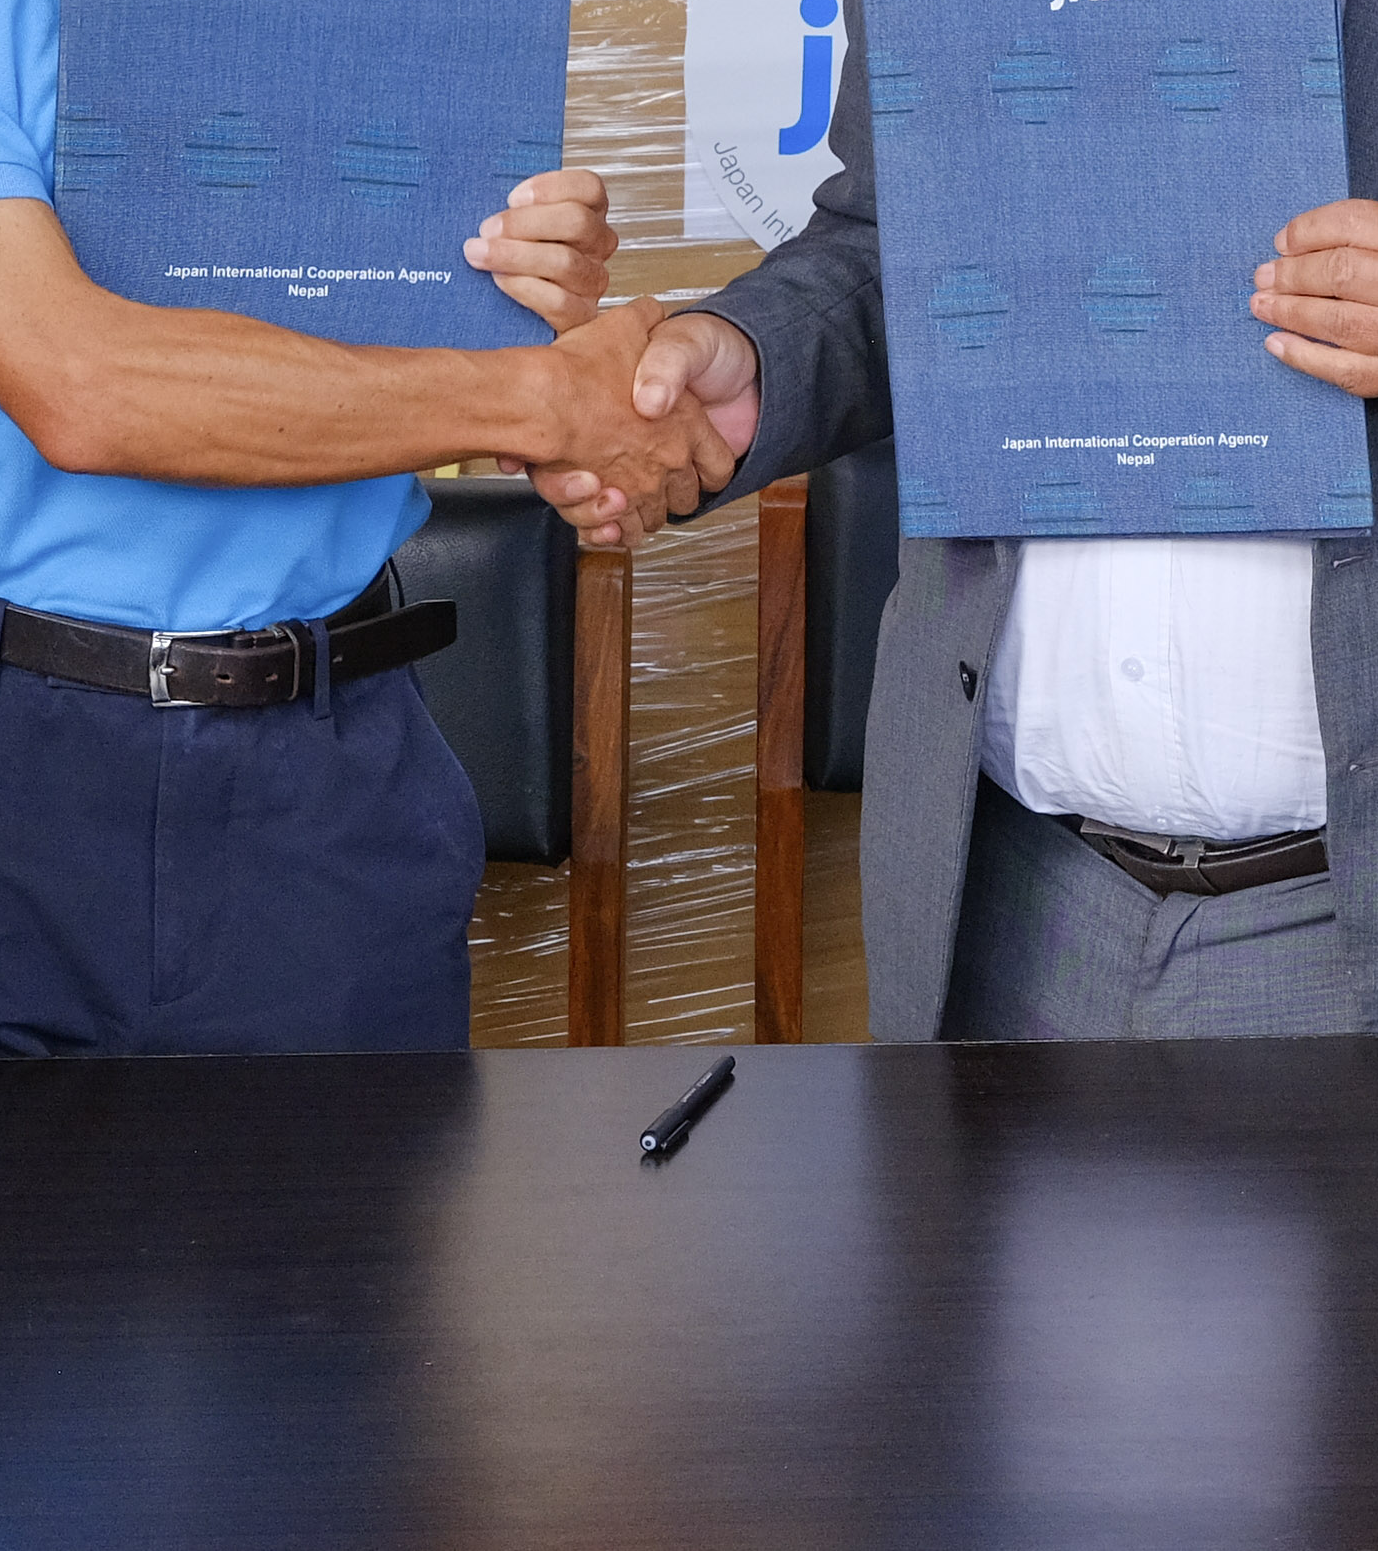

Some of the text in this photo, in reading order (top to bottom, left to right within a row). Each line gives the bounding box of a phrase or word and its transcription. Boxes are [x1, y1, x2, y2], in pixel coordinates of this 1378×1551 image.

[714, 141, 764, 214] Japan
[165, 264, 452, 283] Japan International Cooperation Agency
[288, 284, 329, 299] Nepal
[1001, 432, 1269, 451] Japan International Cooperation Agency
[1117, 452, 1155, 467] Nepal
